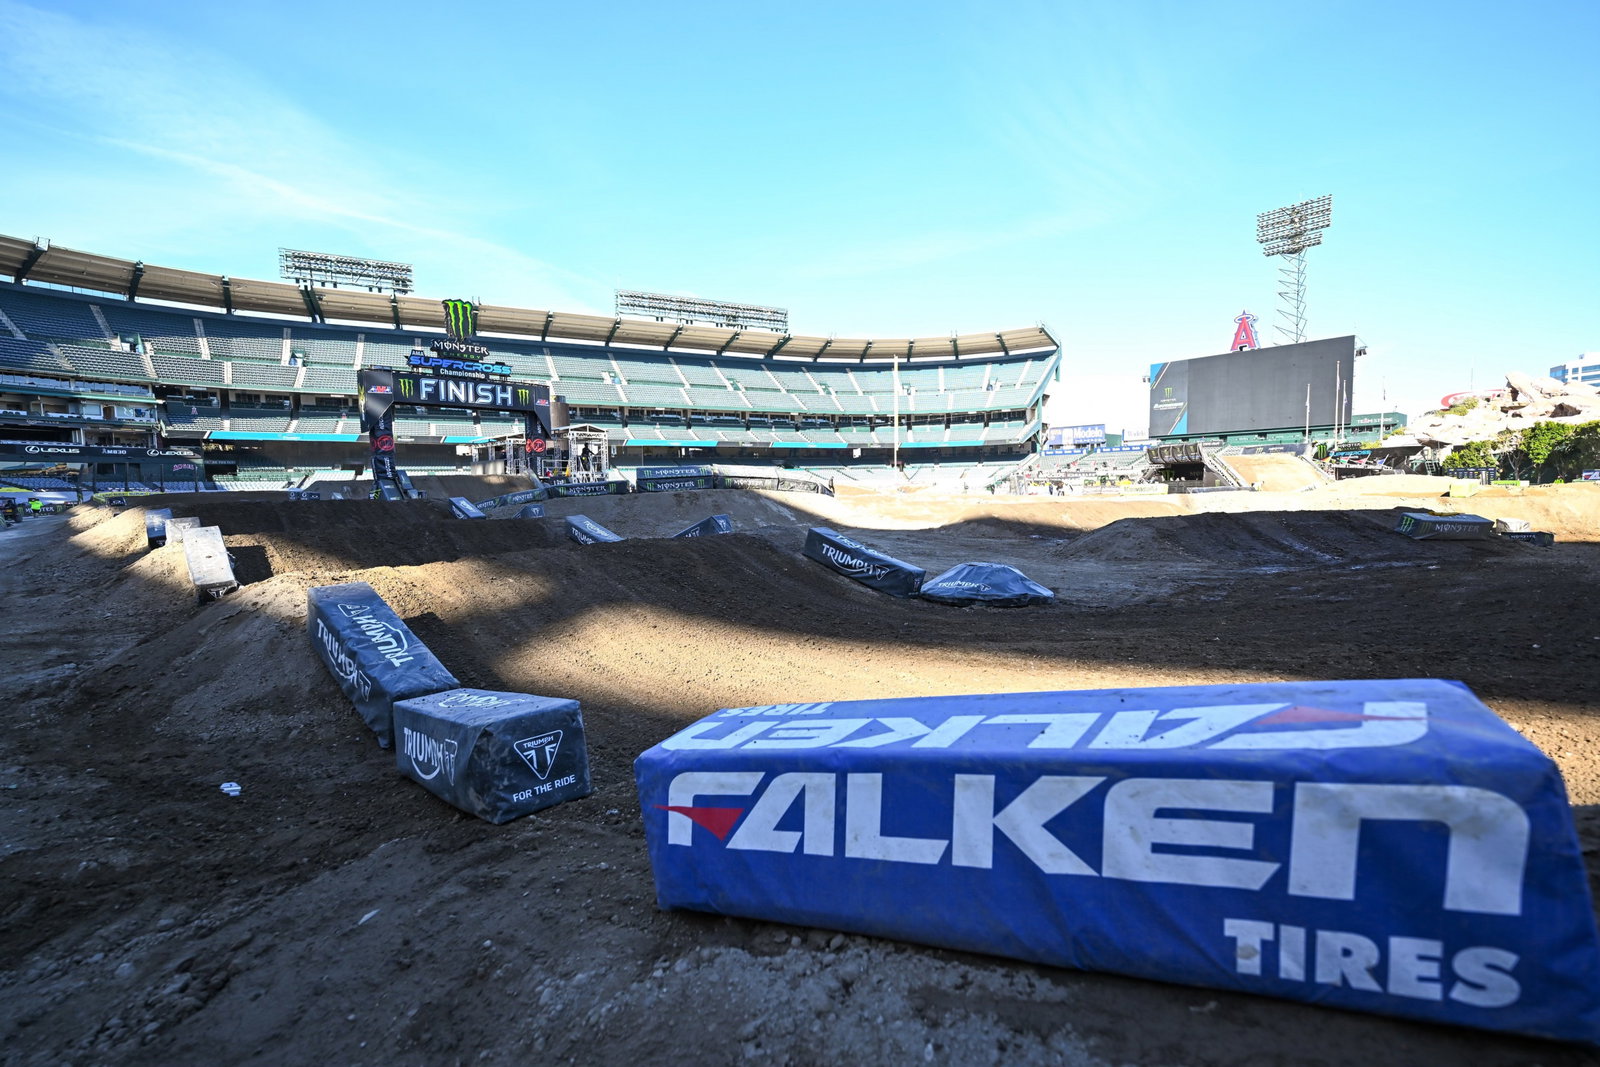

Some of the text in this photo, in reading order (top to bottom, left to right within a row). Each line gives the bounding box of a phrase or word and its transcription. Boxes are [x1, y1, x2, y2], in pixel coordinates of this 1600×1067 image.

[433, 340, 489, 355] MONSTER
[443, 351, 481, 359] ENERGY
[409, 355, 513, 375] SUPERCROSS
[440, 368, 486, 379] Championship
[419, 377, 514, 407] FINISH
[1073, 427, 1103, 438] Modelo
[655, 468, 697, 476] MONSTER
[569, 485, 607, 493] MONSTER
[657, 481, 695, 489] MONSTER
[1435, 523, 1480, 533] MONSTER
[822, 543, 873, 575] TRIUMPH
[938, 580, 980, 589] TRIUMPH
[353, 614, 415, 668] TRIUMPH
[317, 618, 359, 689] TRIUMPH
[718, 703, 836, 718] TIRES
[660, 702, 1429, 750] FALKEN
[523, 735, 555, 749] TRIUMPH
[404, 727, 446, 780] TRIUMPH
[513, 774, 576, 803] FOR THE RIDE
[654, 770, 1531, 916] FALKEN
[1223, 918, 1522, 1008] TIRES
